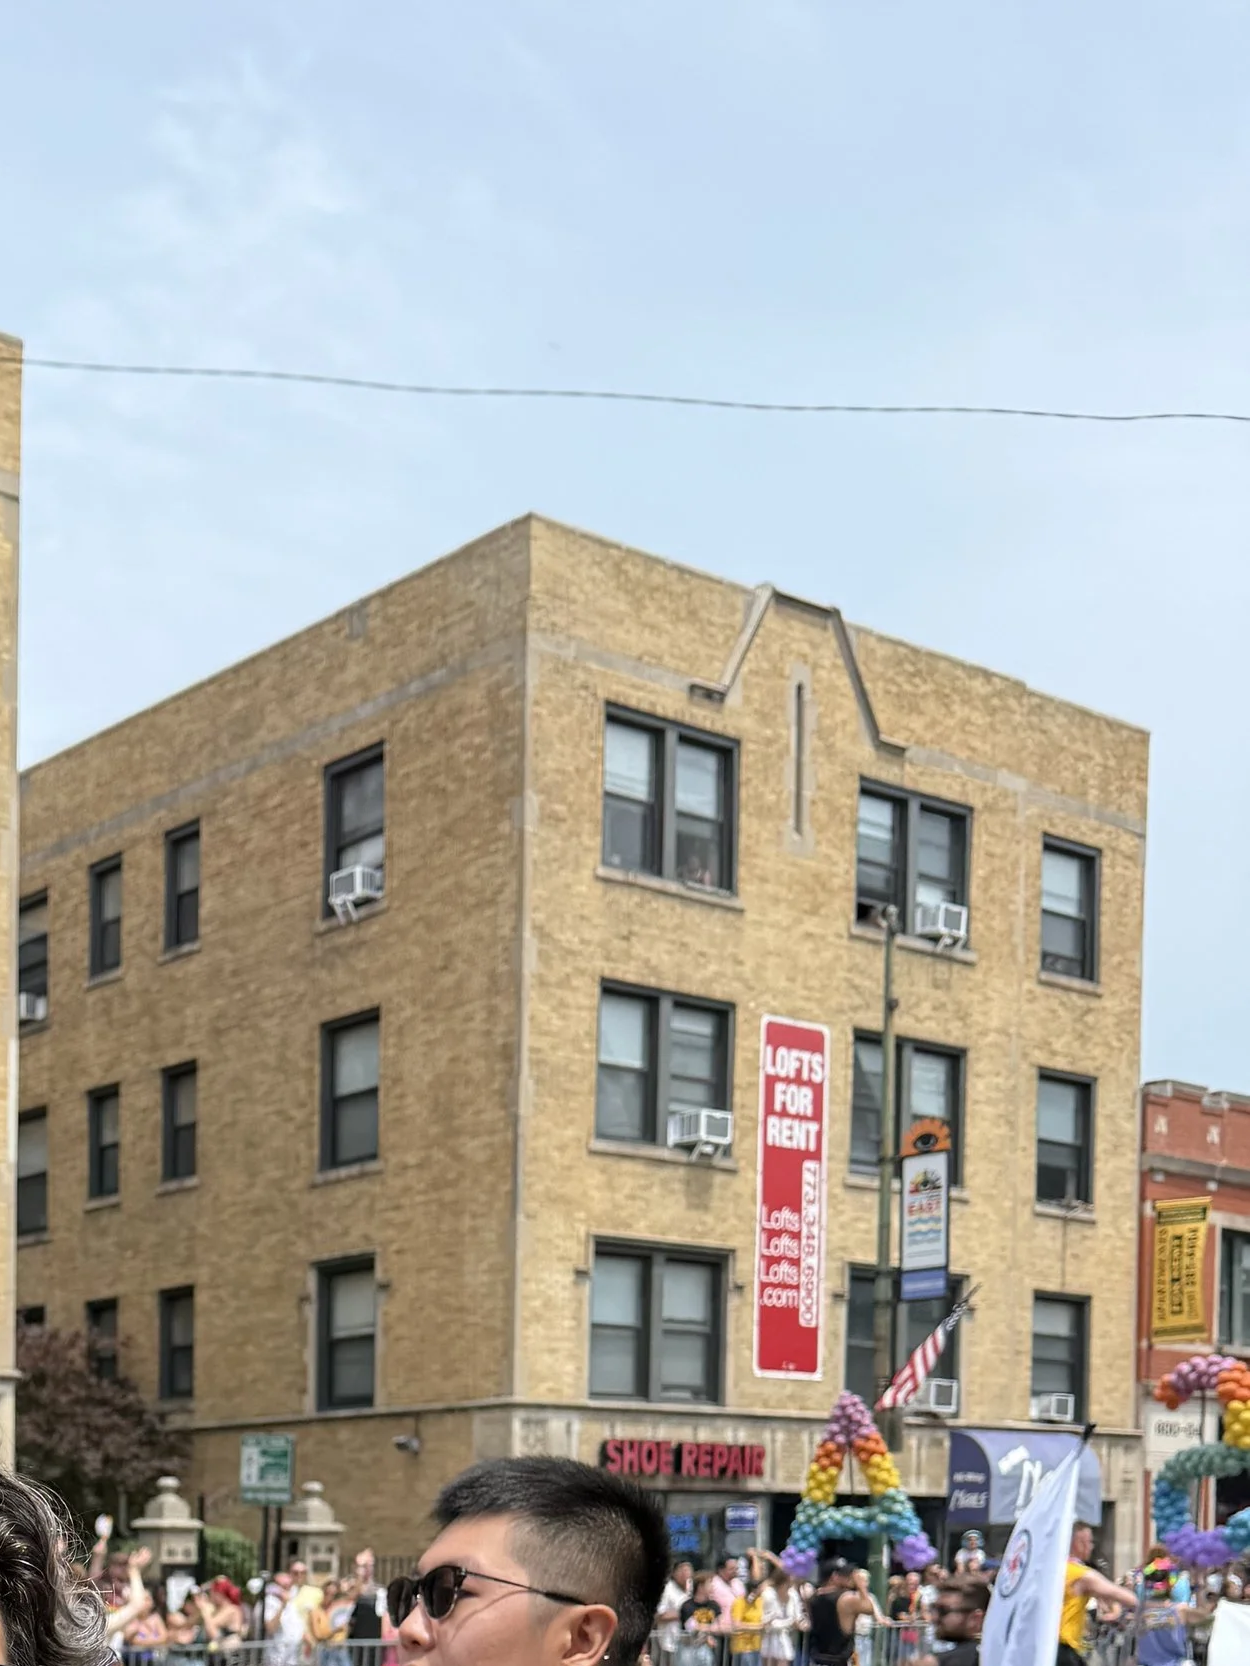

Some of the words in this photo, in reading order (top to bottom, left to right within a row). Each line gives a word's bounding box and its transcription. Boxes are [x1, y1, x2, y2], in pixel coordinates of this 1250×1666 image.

[765, 1044, 824, 1084] LOFTS
[773, 1081, 814, 1117] FOR
[766, 1114, 820, 1152] RENT
[761, 1205, 801, 1232] Lofts
[760, 1232, 800, 1259] Lofts
[759, 1259, 800, 1285] Lofts
[759, 1286, 800, 1309] .com
[605, 1439, 673, 1475] SHOE
[681, 1442, 766, 1478] REPAIR
